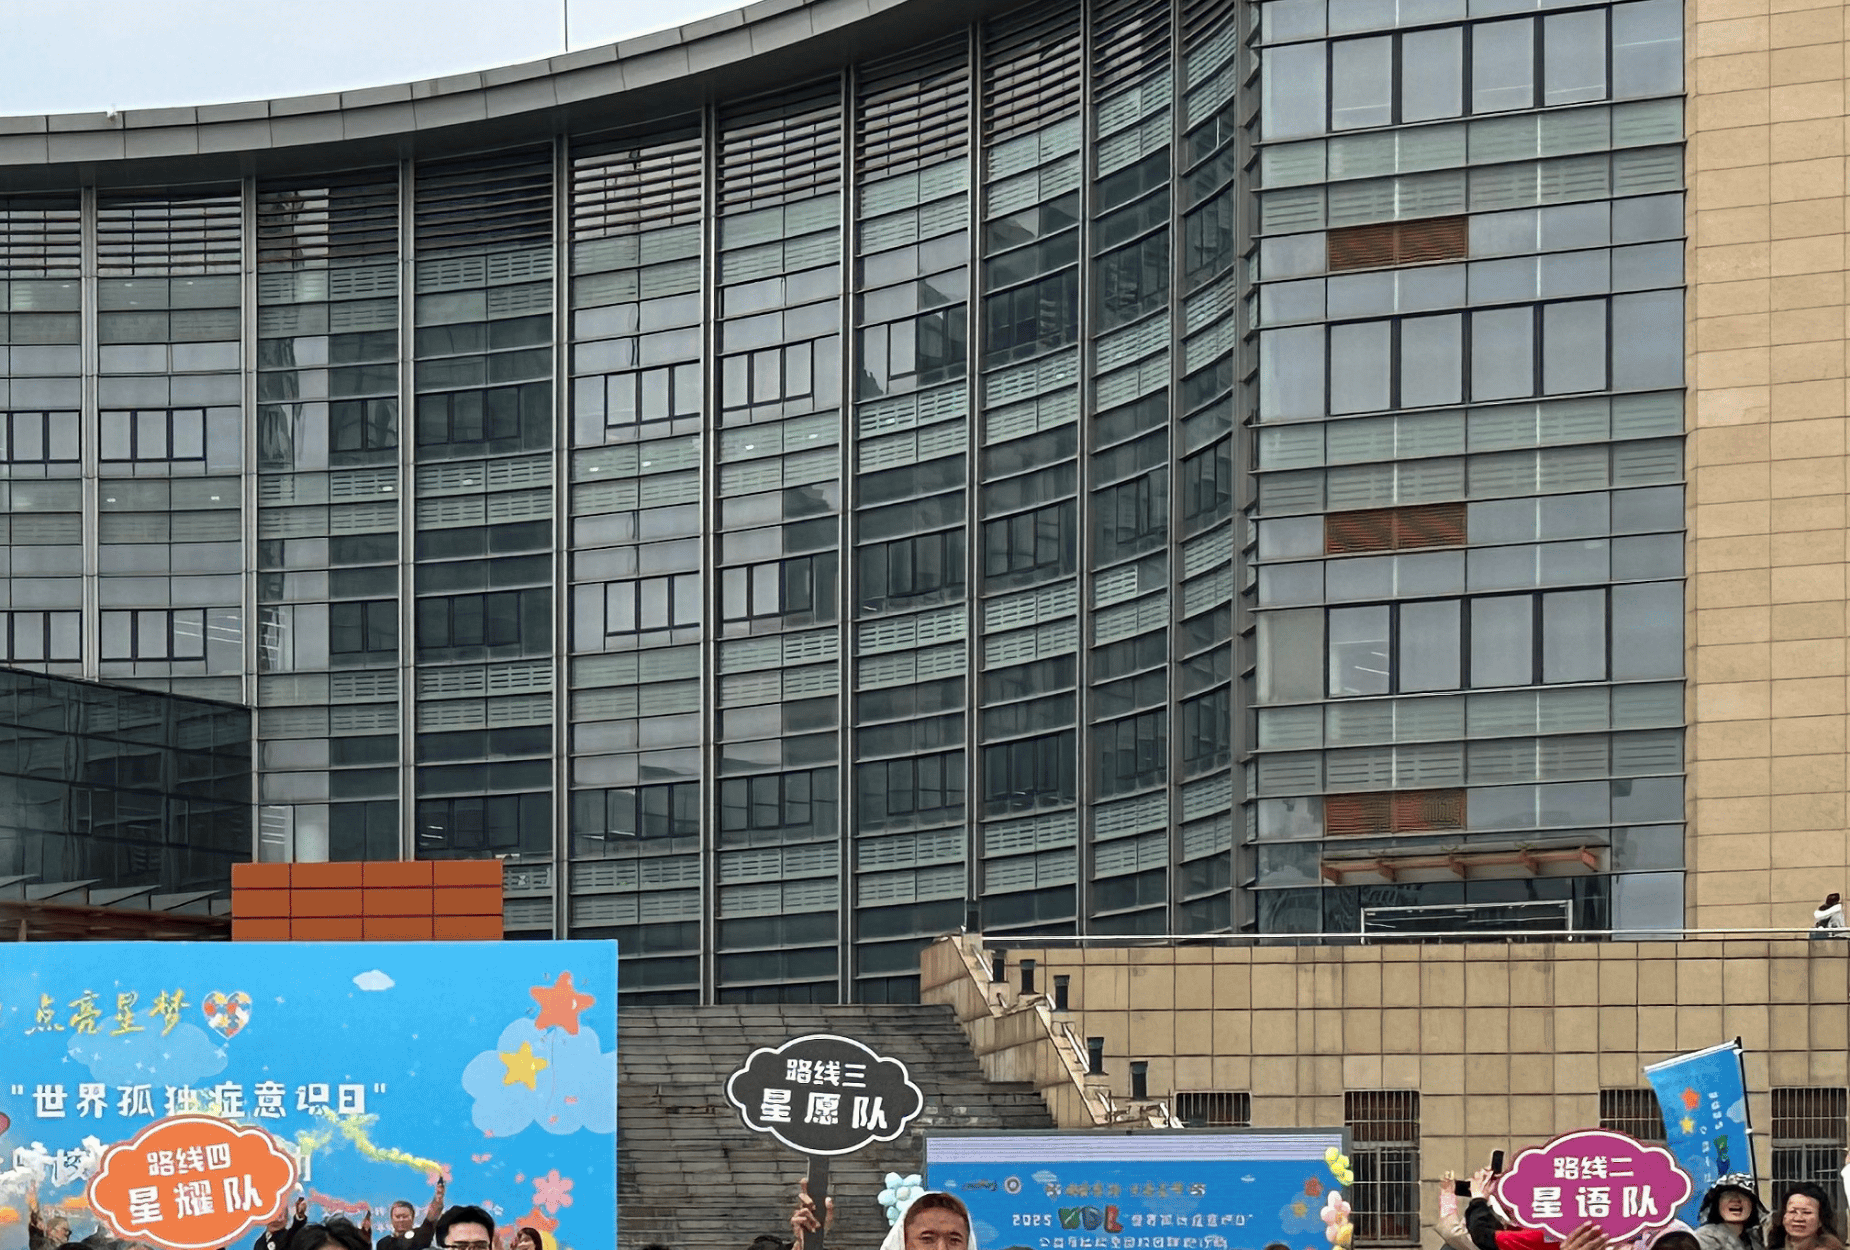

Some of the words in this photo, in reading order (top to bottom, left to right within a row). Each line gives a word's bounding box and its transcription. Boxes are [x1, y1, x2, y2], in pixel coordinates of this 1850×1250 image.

[24, 988, 190, 1037] 点亮星梦
[786, 1059, 866, 1087] 路线三
[760, 1088, 888, 1130] 星愿队
[147, 1143, 231, 1176] 路线四
[1553, 1156, 1634, 1179] 路线二
[128, 1174, 263, 1225] 星耀队
[1532, 1185, 1658, 1218] 星语队
